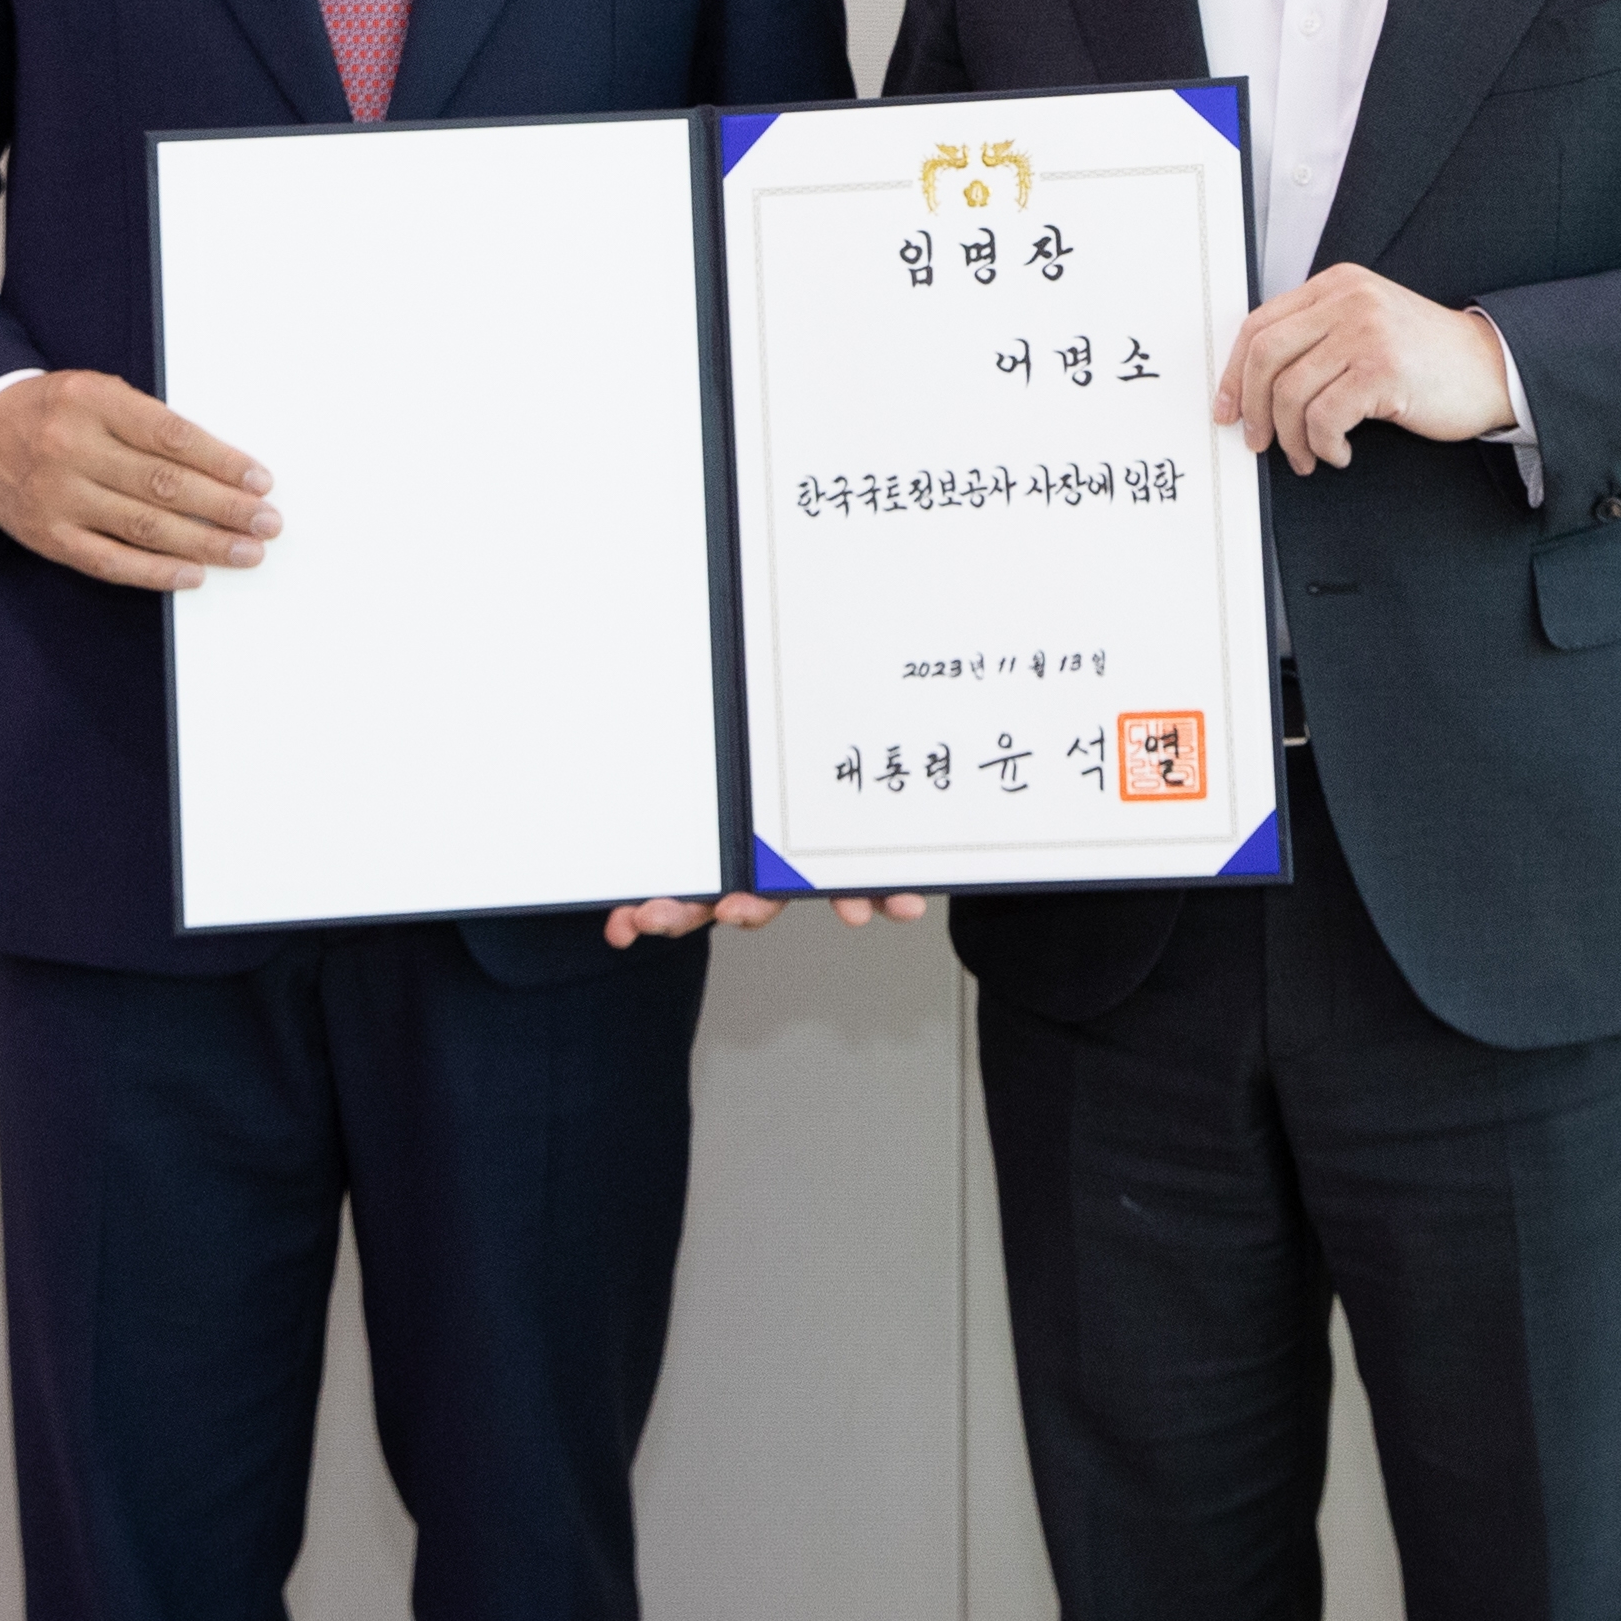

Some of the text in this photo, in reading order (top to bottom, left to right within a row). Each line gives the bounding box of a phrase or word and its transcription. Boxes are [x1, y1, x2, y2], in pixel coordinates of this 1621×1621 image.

[797, 463, 1019, 518] 한국국토정보공사
[1025, 460, 1116, 507] 사장에
[835, 743, 953, 793] 대통령
